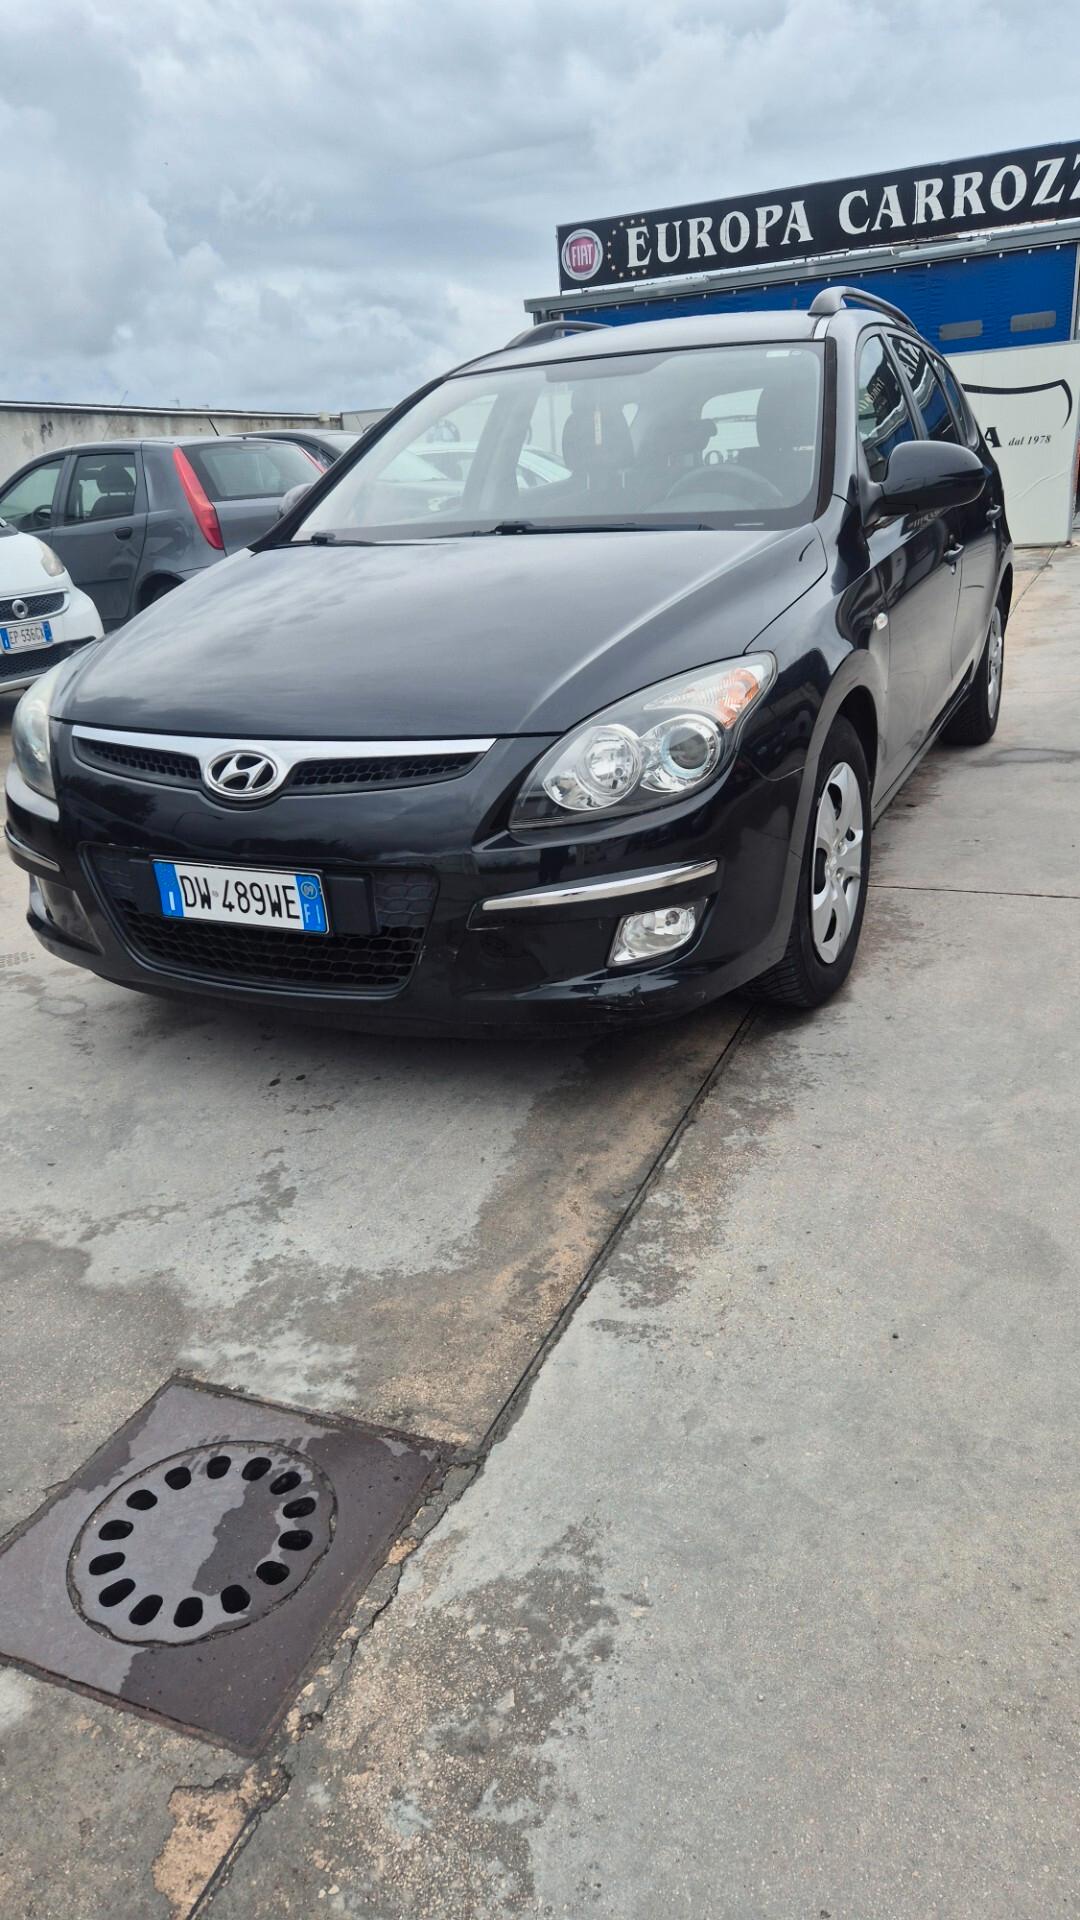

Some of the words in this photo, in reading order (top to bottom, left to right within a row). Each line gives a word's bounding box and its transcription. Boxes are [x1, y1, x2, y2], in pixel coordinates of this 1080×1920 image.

[626, 200, 814, 268] EUROPA
[571, 243, 593, 267] FIAT
[1008, 436, 1024, 446] dal
[1027, 434, 1051, 445] 1978
[180, 875, 211, 910] DW
[222, 879, 300, 920] 489WE
